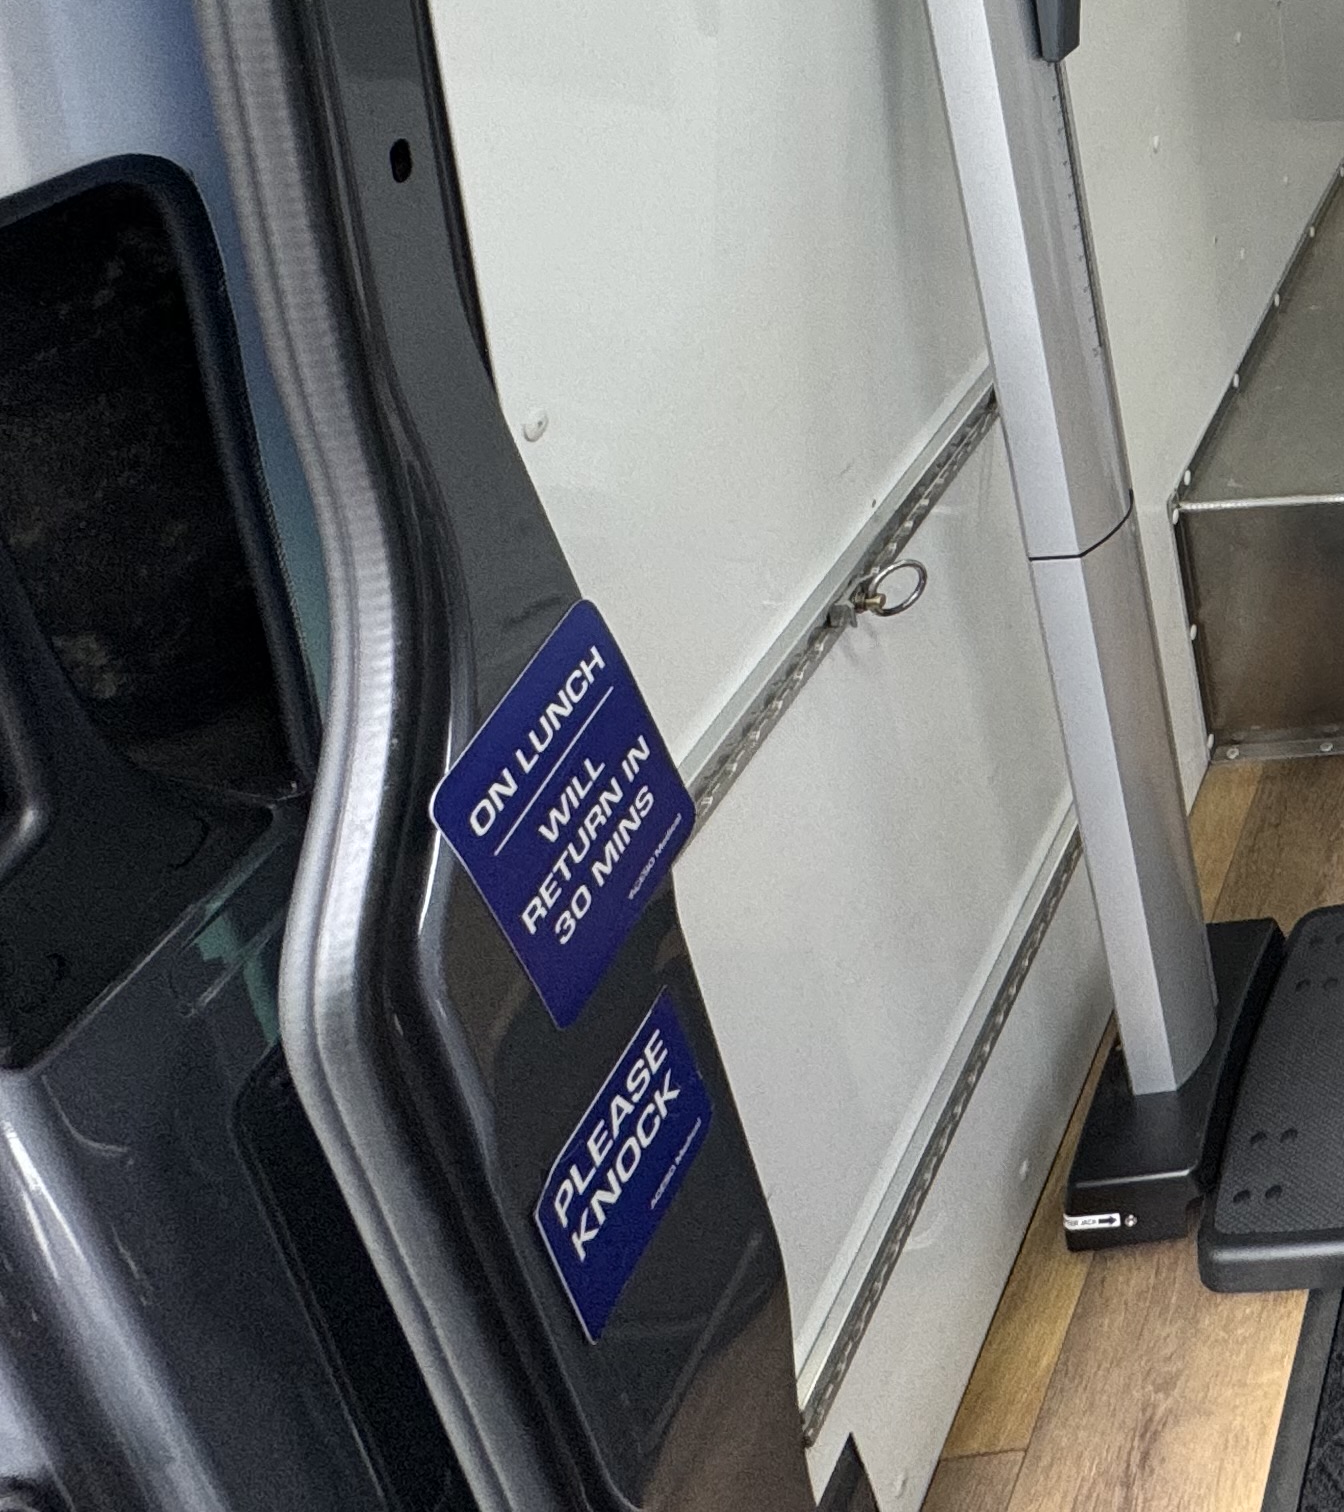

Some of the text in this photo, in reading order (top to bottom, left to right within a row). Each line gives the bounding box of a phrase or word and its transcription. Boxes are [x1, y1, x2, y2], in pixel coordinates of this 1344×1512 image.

[469, 645, 606, 837] ON LUNCH
[520, 735, 651, 935] RETURN IN
[538, 758, 606, 843] WILL
[554, 785, 655, 945] 30 MINS
[554, 1029, 668, 1228] PLEASE
[571, 1068, 681, 1263] KNOCK
